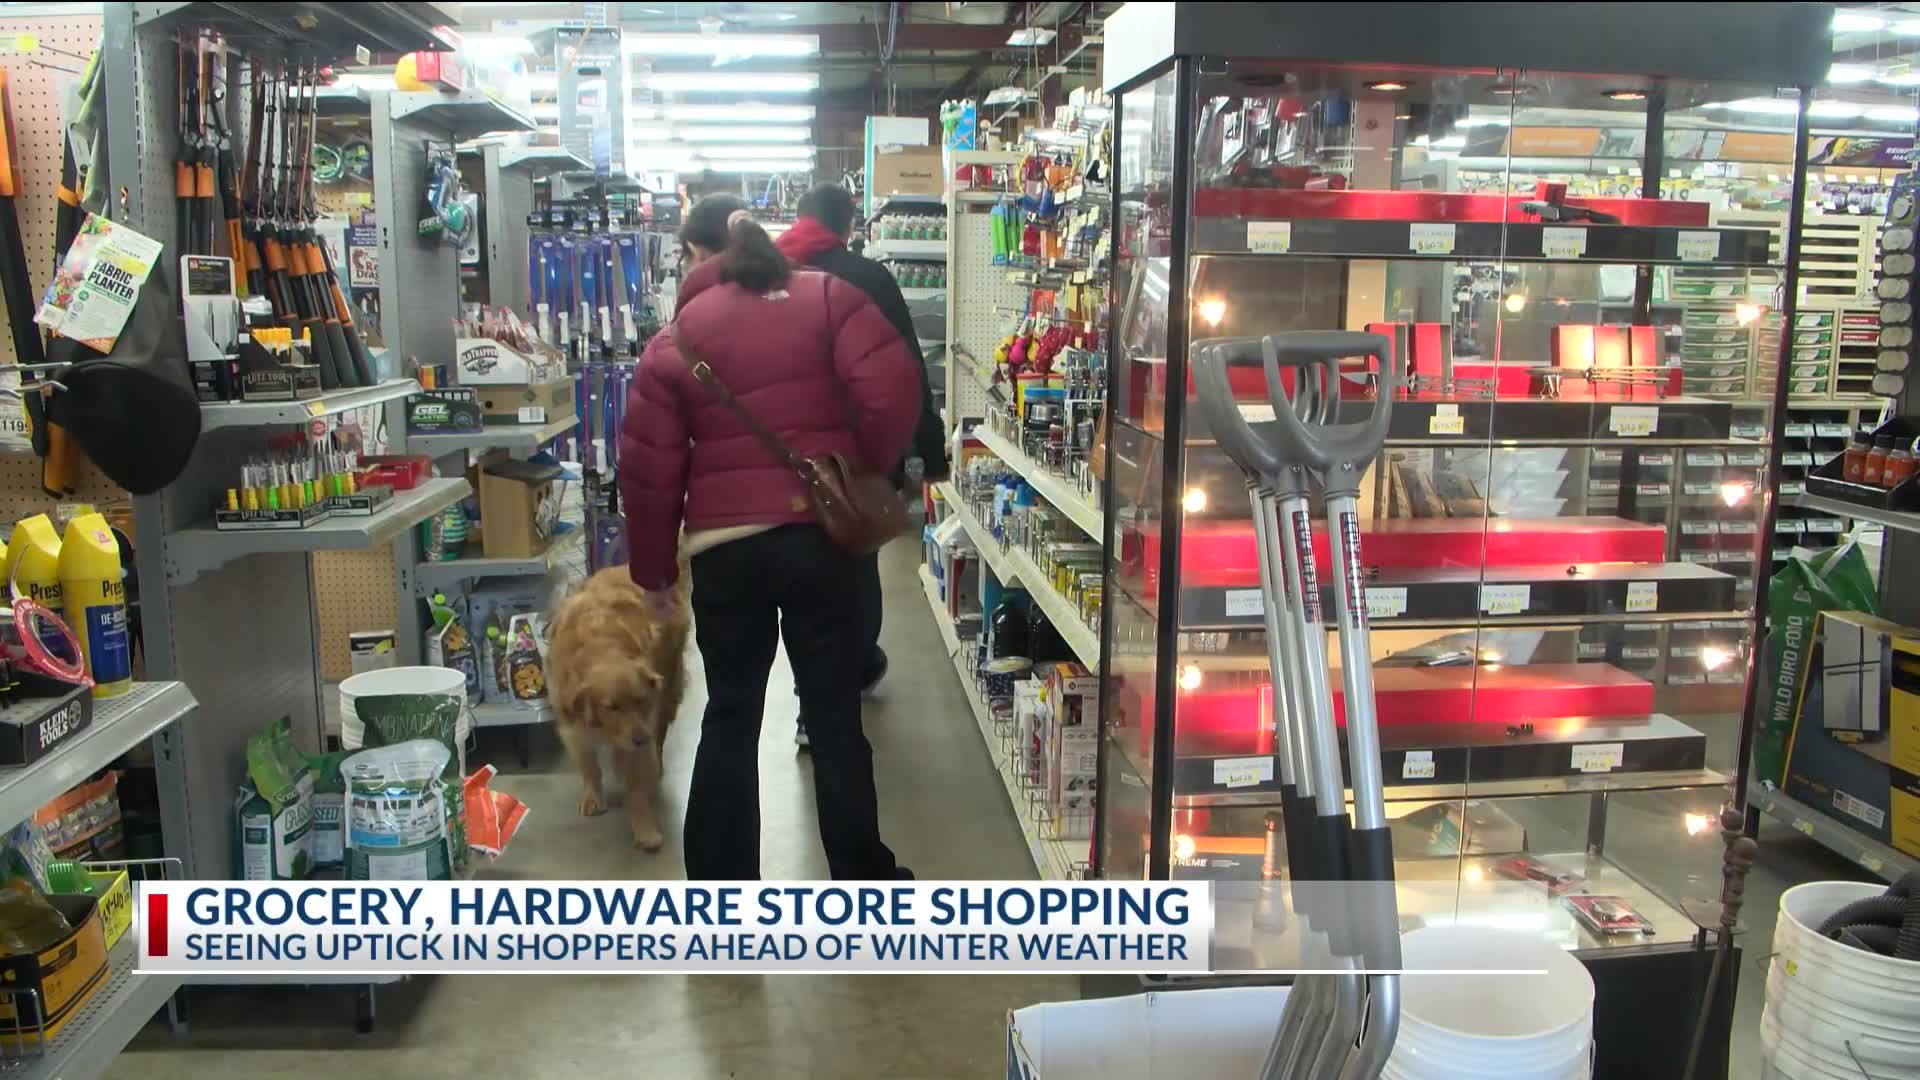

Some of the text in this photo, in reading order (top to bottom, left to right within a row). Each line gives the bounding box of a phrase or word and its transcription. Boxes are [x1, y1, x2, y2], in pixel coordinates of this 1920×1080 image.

[87, 271, 135, 300] PLANTER
[93, 261, 133, 285] FABRIC
[1779, 650, 1799, 686] BIRD
[1773, 687, 1793, 721] WILD
[39, 708, 68, 736] KLEIN
[39, 721, 69, 749] TOOLS
